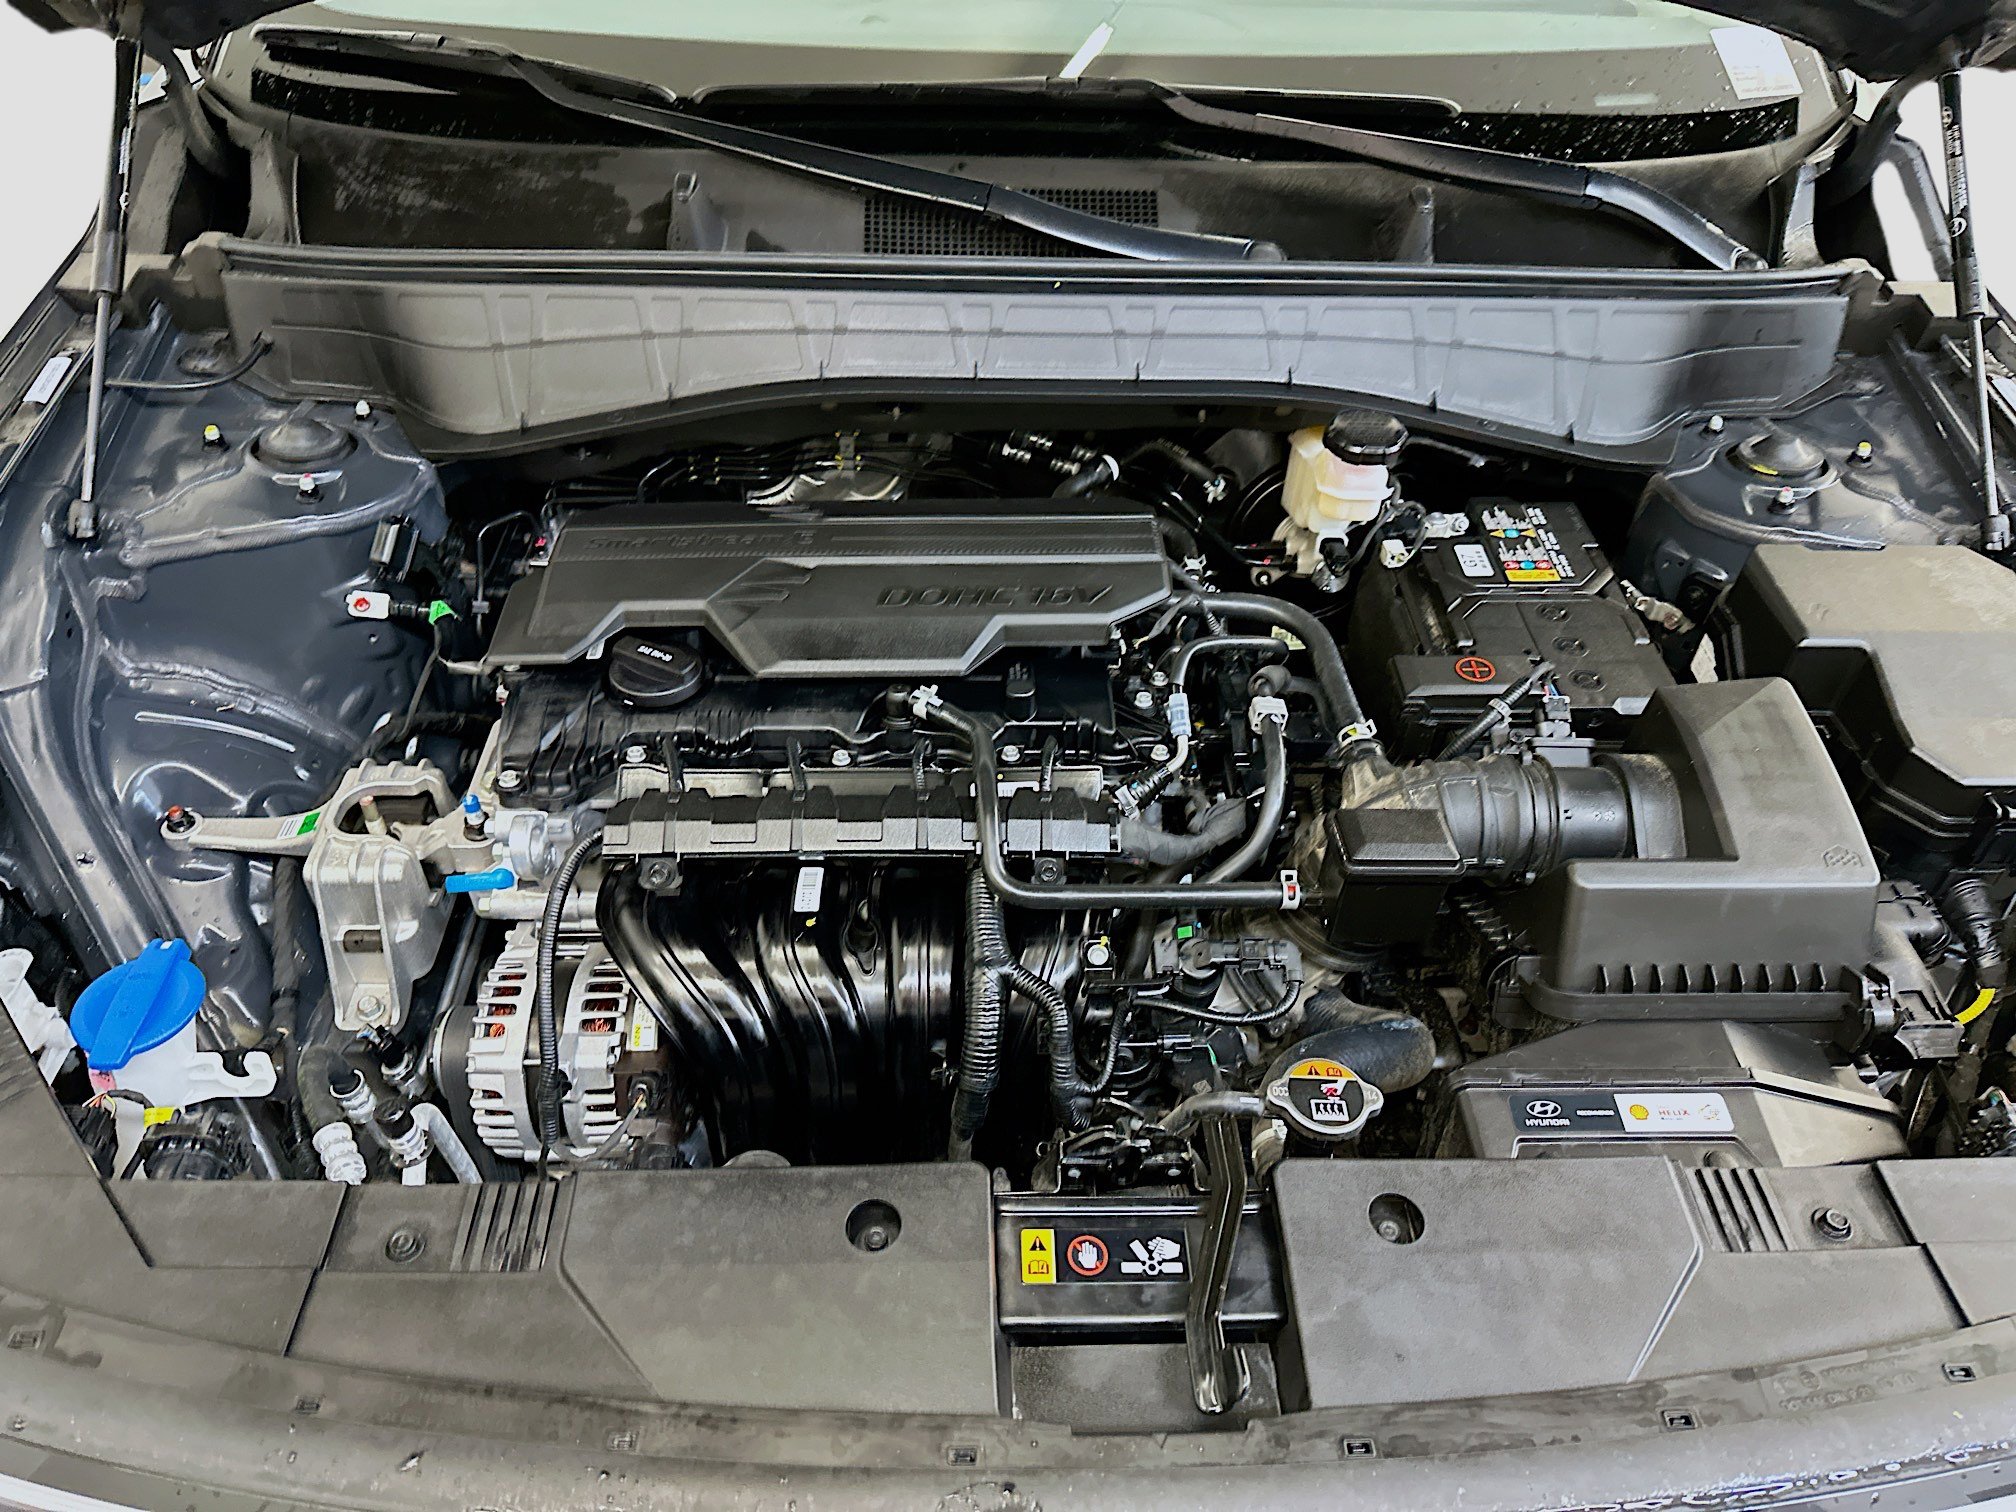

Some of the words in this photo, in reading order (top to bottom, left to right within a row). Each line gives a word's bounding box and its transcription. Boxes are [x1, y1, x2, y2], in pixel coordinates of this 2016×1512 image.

[877, 584, 1022, 608] DOHC
[1028, 583, 1113, 607] 16V
[1525, 1119, 1570, 1127] HYUNDAI
